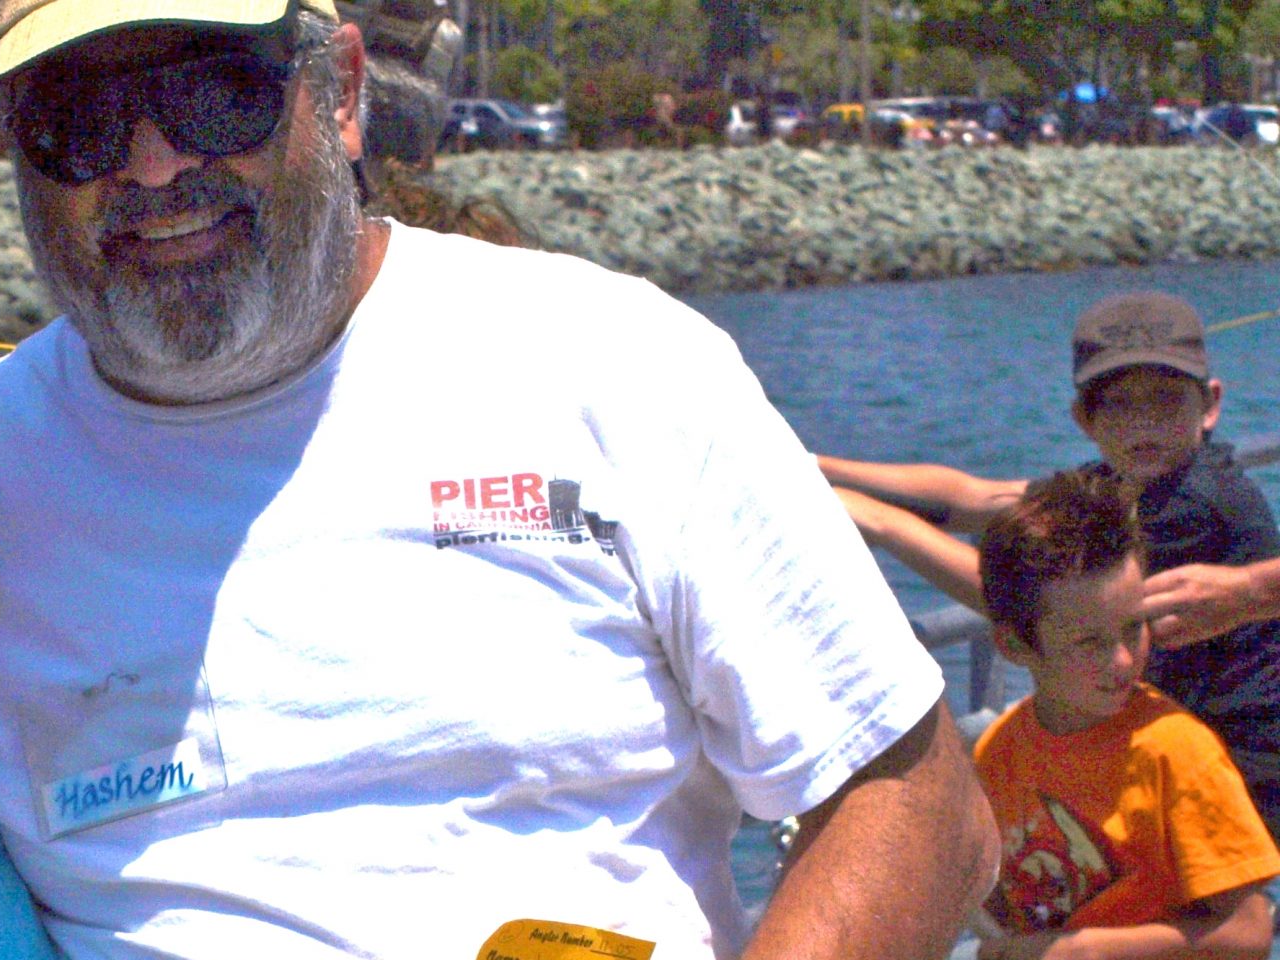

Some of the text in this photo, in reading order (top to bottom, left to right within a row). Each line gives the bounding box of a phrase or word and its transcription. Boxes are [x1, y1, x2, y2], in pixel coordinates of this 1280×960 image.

[430, 472, 546, 510] PIER
[433, 521, 451, 533] IN
[54, 760, 195, 819] Hashem
[529, 928, 559, 943] Angler
[560, 932, 594, 948] Number
